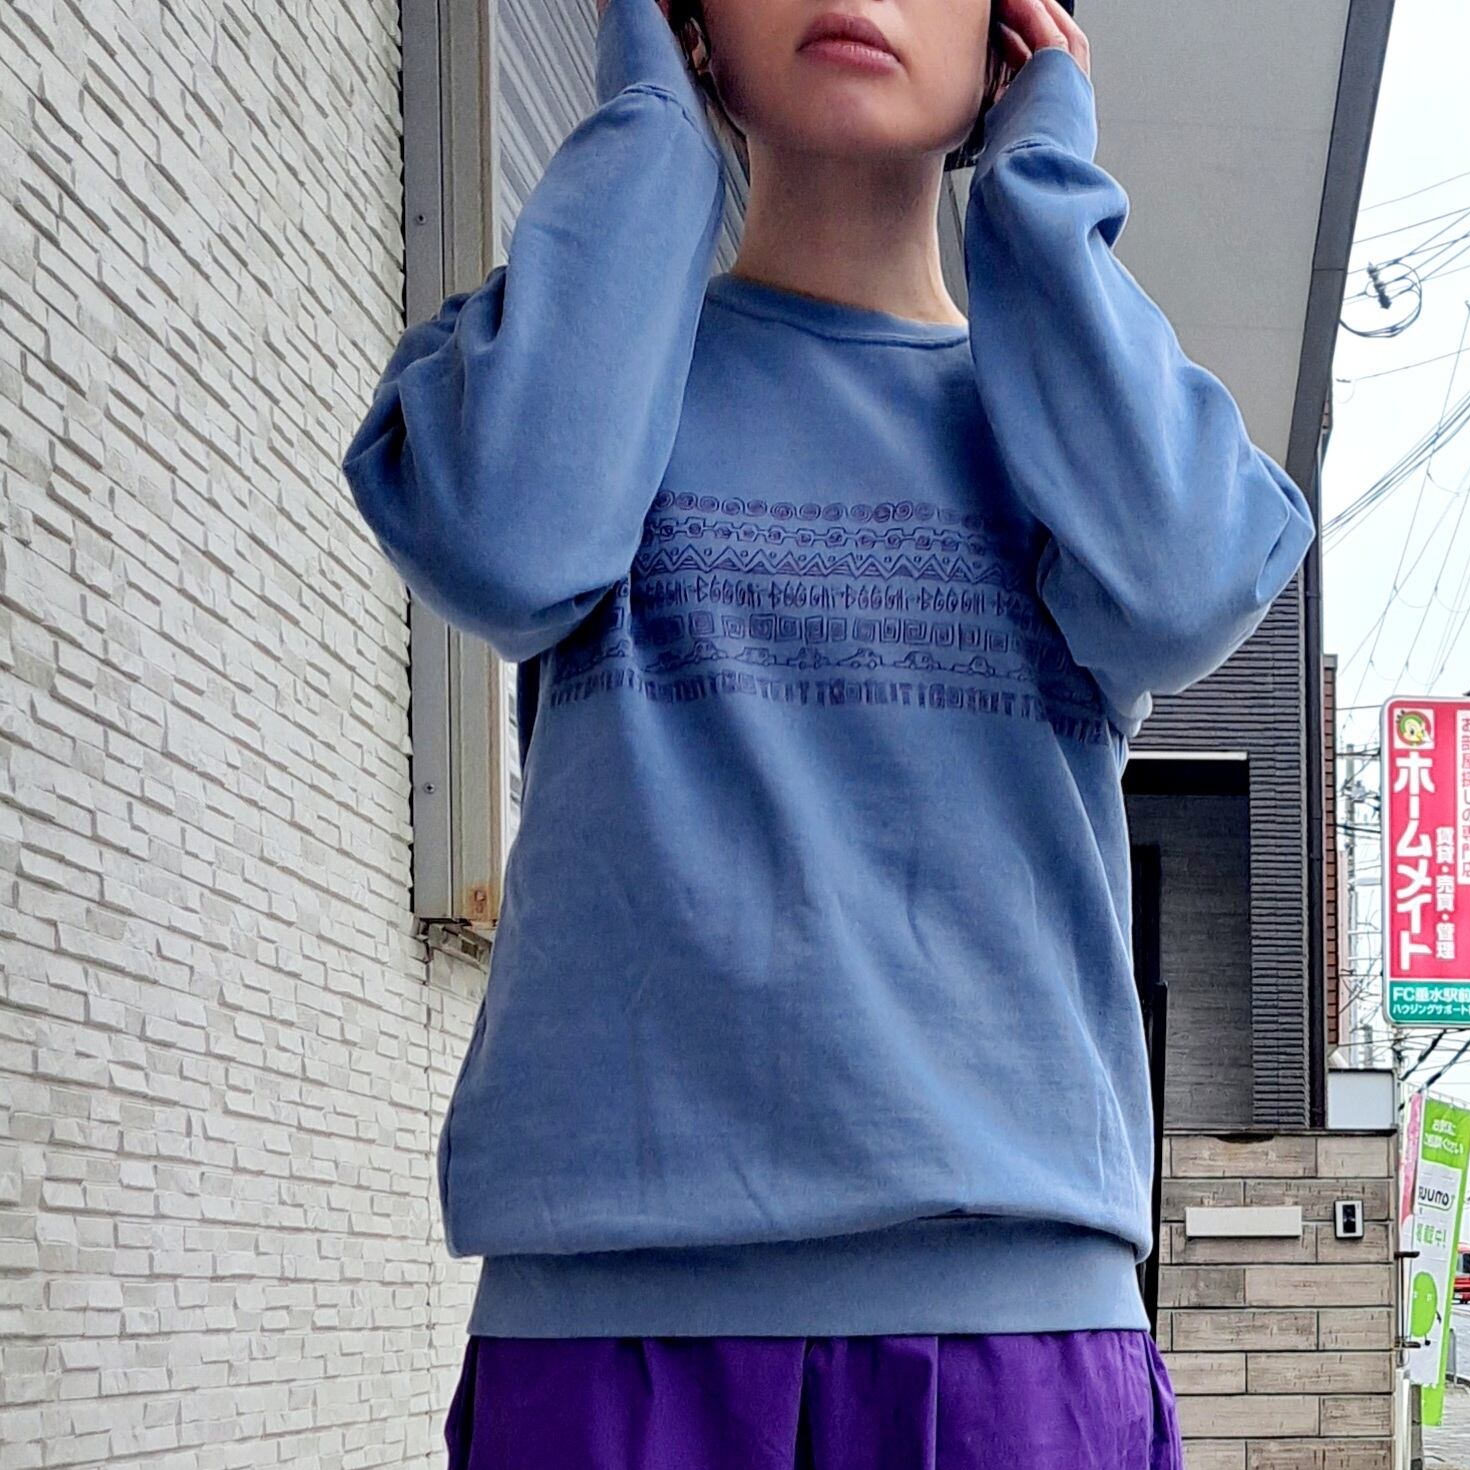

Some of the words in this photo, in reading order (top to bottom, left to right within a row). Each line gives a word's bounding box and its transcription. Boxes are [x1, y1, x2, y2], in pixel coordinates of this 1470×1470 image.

[1393, 751, 1435, 970] ホームメイト
